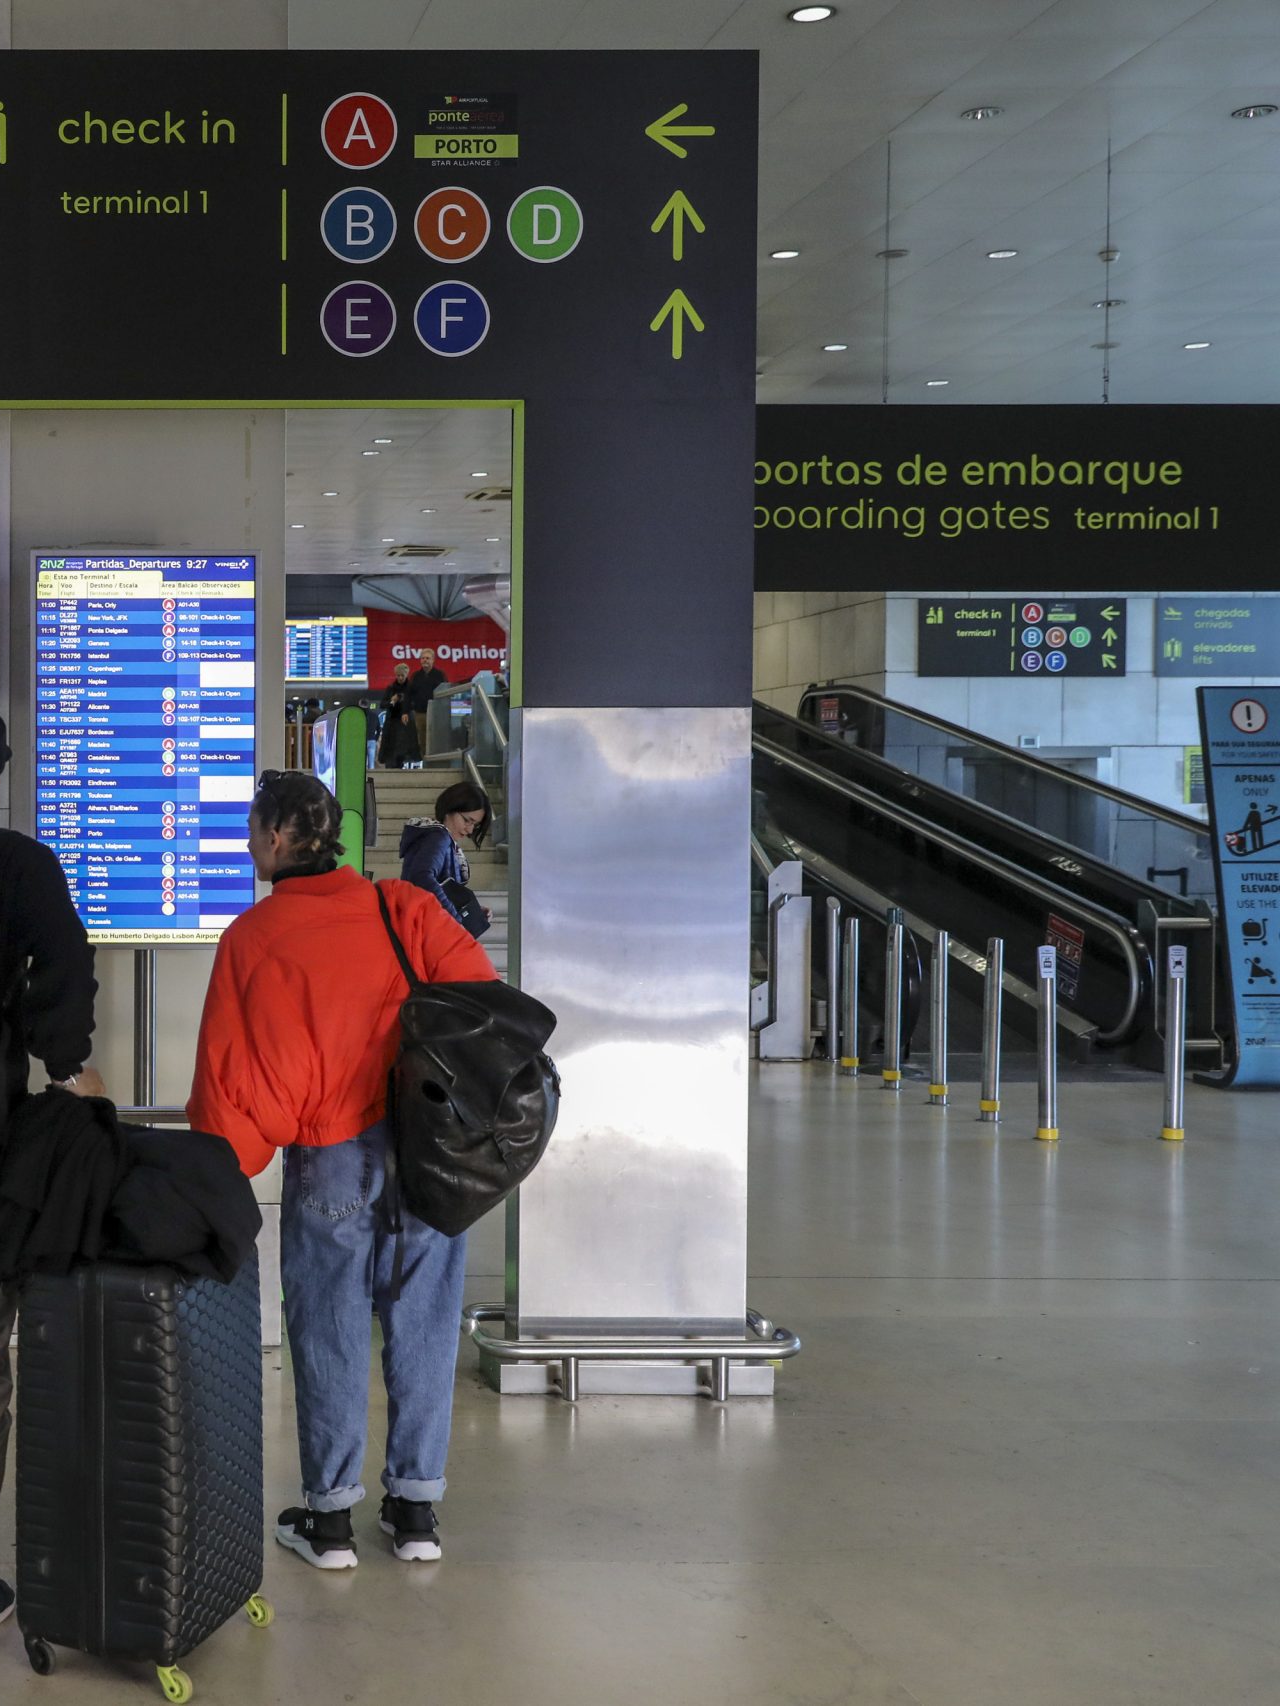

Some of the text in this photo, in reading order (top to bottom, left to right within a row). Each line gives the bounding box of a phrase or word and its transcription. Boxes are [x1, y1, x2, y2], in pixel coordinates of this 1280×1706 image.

[58, 110, 235, 144] check in
[342, 107, 377, 150] A
[435, 139, 497, 154] PORTO
[60, 190, 207, 214] terminal 1
[345, 203, 562, 246] B C D
[345, 298, 467, 339] E F
[897, 454, 947, 485] de
[962, 454, 1182, 494] embarque
[940, 501, 1049, 537] gates
[1074, 506, 1199, 529] terminal
[1210, 507, 1218, 529] 1
[85, 559, 181, 570] Partidas_Departures
[186, 560, 207, 569] 9:27
[954, 609, 1002, 619] check in
[1194, 608, 1250, 619] chegadas
[391, 644, 423, 660] Giv
[1193, 642, 1256, 652] elevadores
[1234, 774, 1275, 783] APENAS
[1242, 788, 1269, 796] ONLY
[1241, 872, 1279, 881] UTILIZE
[1237, 900, 1278, 909] USE THE
